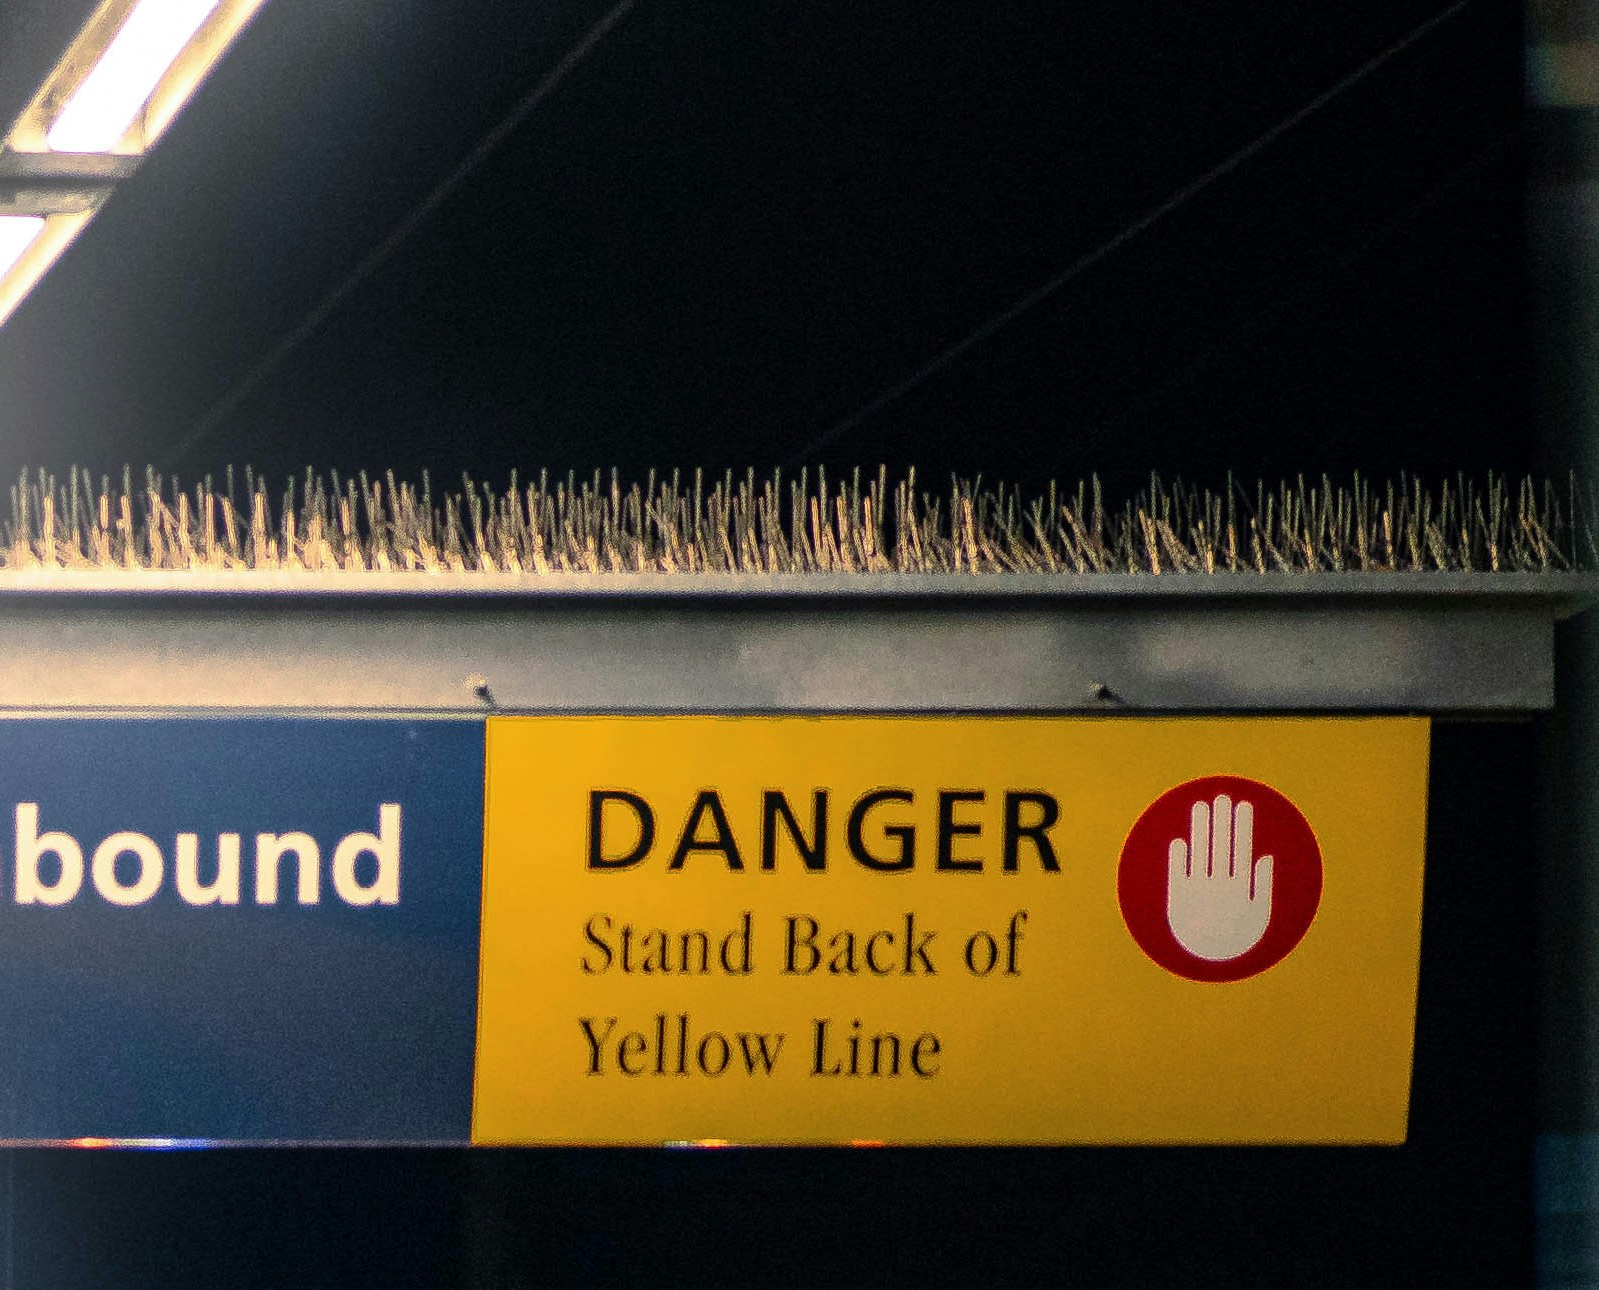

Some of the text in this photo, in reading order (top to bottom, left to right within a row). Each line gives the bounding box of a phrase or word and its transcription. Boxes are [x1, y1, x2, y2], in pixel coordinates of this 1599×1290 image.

[586, 789, 1061, 872] DANGER
[581, 910, 1030, 976] Stand Back of
[578, 1012, 943, 1077] Yellow Line
